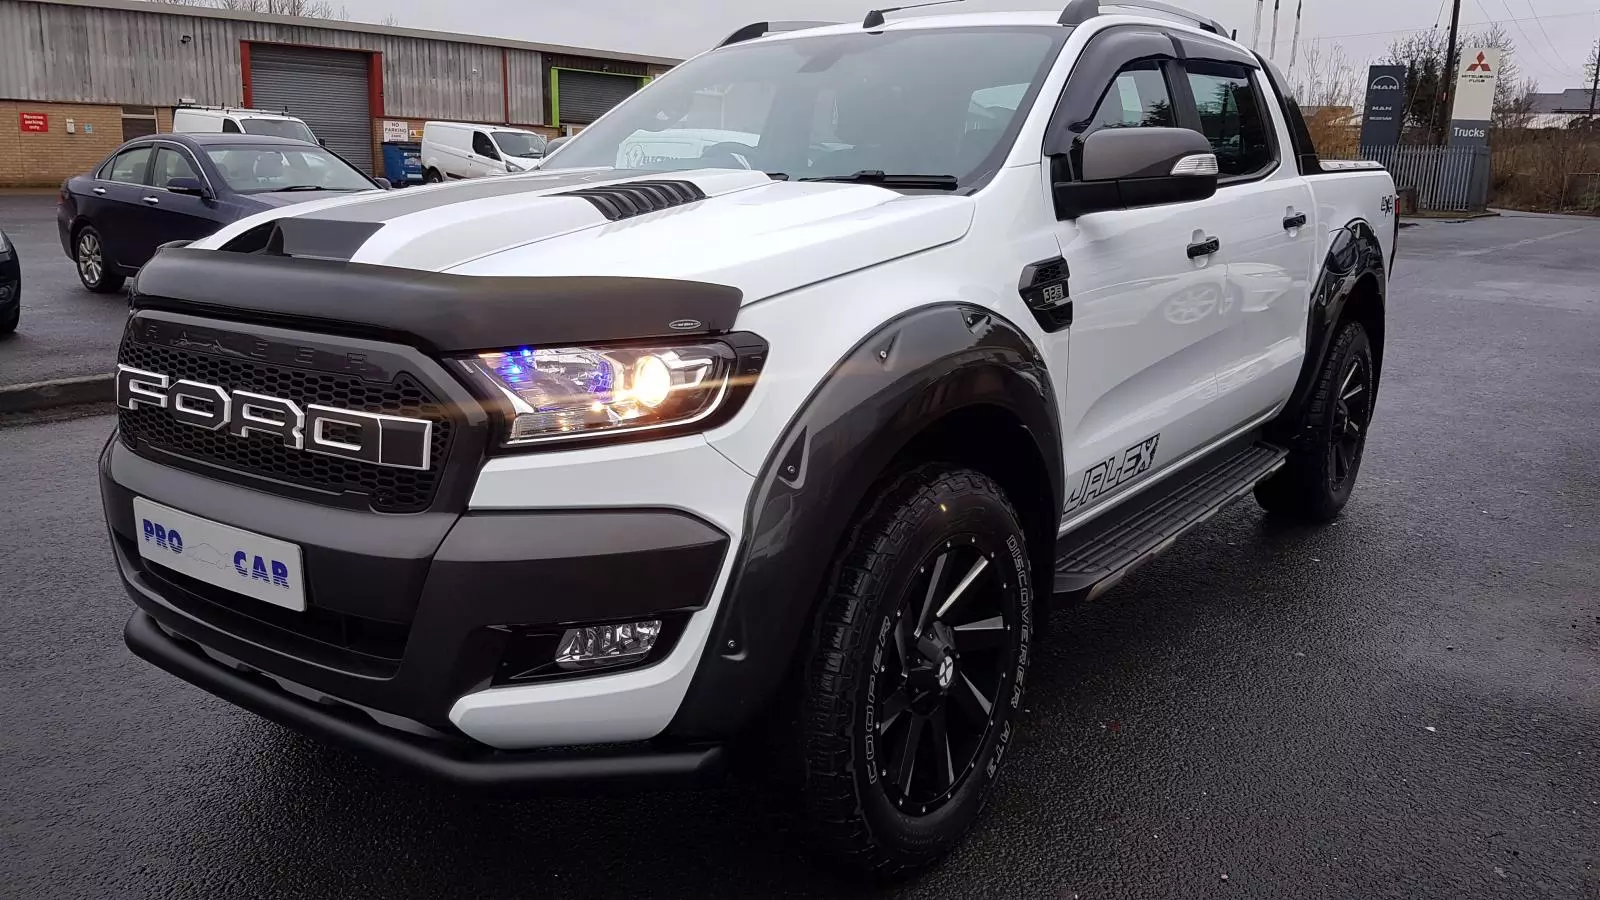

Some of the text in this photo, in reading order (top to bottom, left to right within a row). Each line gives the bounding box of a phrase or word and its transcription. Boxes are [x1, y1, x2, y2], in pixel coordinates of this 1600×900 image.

[1453, 127, 1485, 138] Trucks
[116, 362, 433, 472] FORD
[142, 518, 290, 590] PRO CAR
[1006, 533, 1030, 709] DISCOVERER
[865, 615, 891, 785] COOPER
